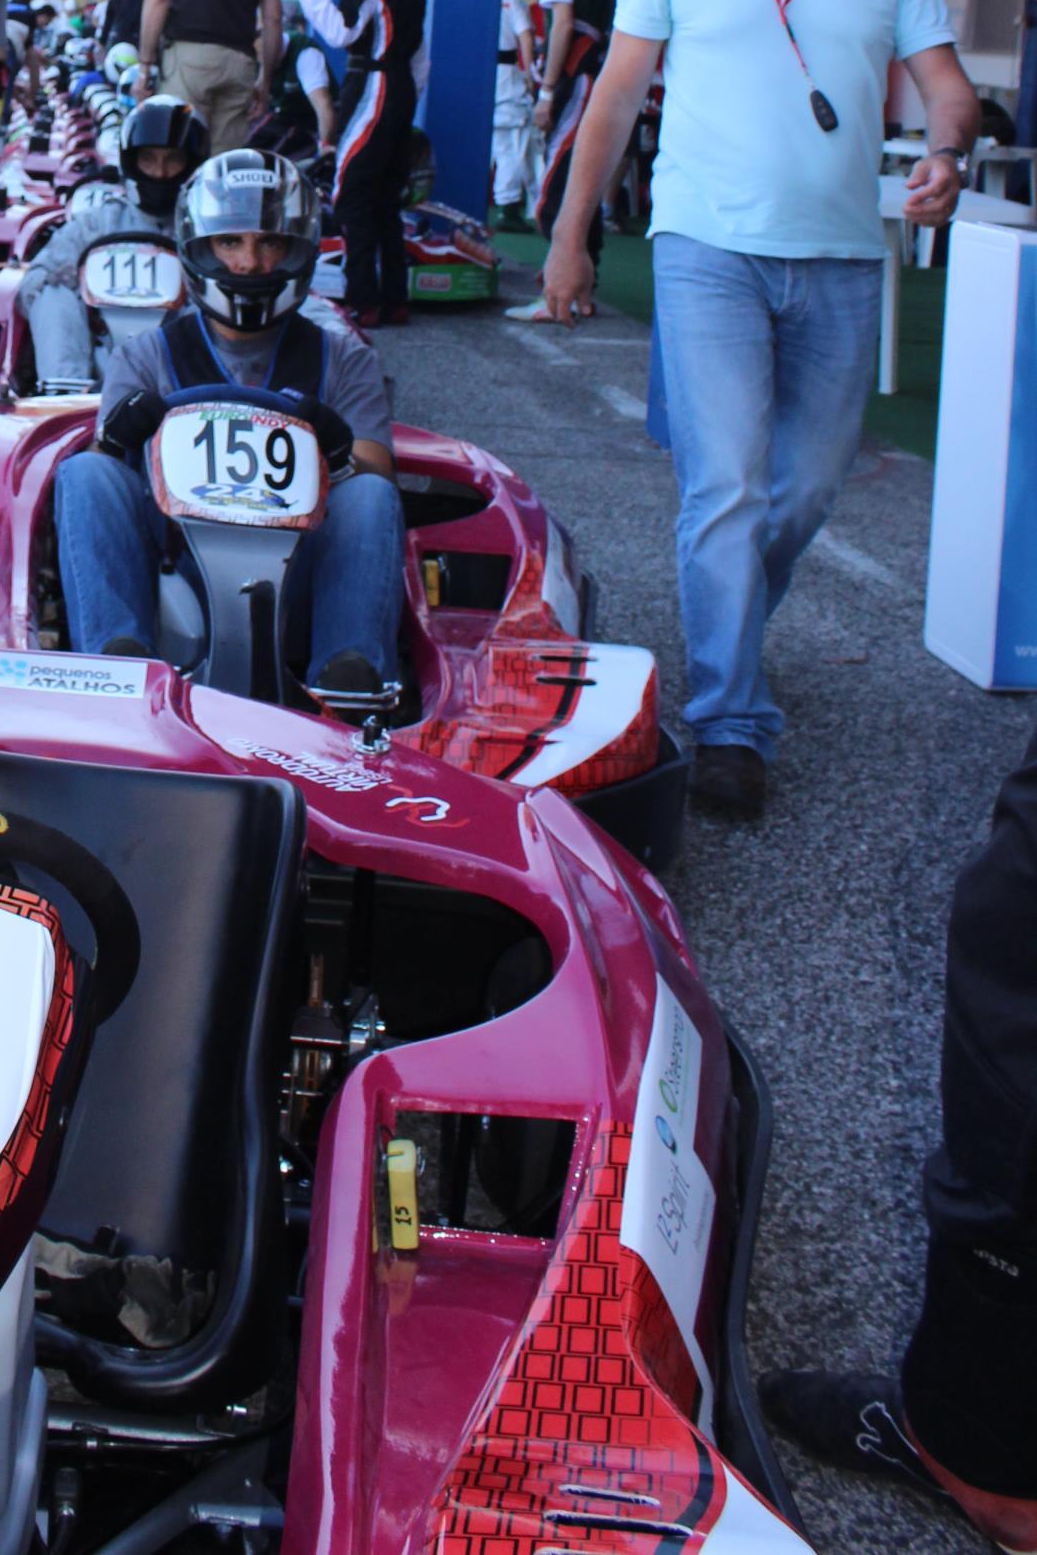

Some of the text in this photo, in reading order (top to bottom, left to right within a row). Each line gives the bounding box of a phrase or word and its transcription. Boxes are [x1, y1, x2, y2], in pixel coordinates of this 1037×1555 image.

[103, 252, 157, 289] 111
[194, 419, 296, 490] 159
[29, 664, 112, 681] pequenos
[28, 677, 136, 694] ATALHOS
[393, 1204, 413, 1226] 15
